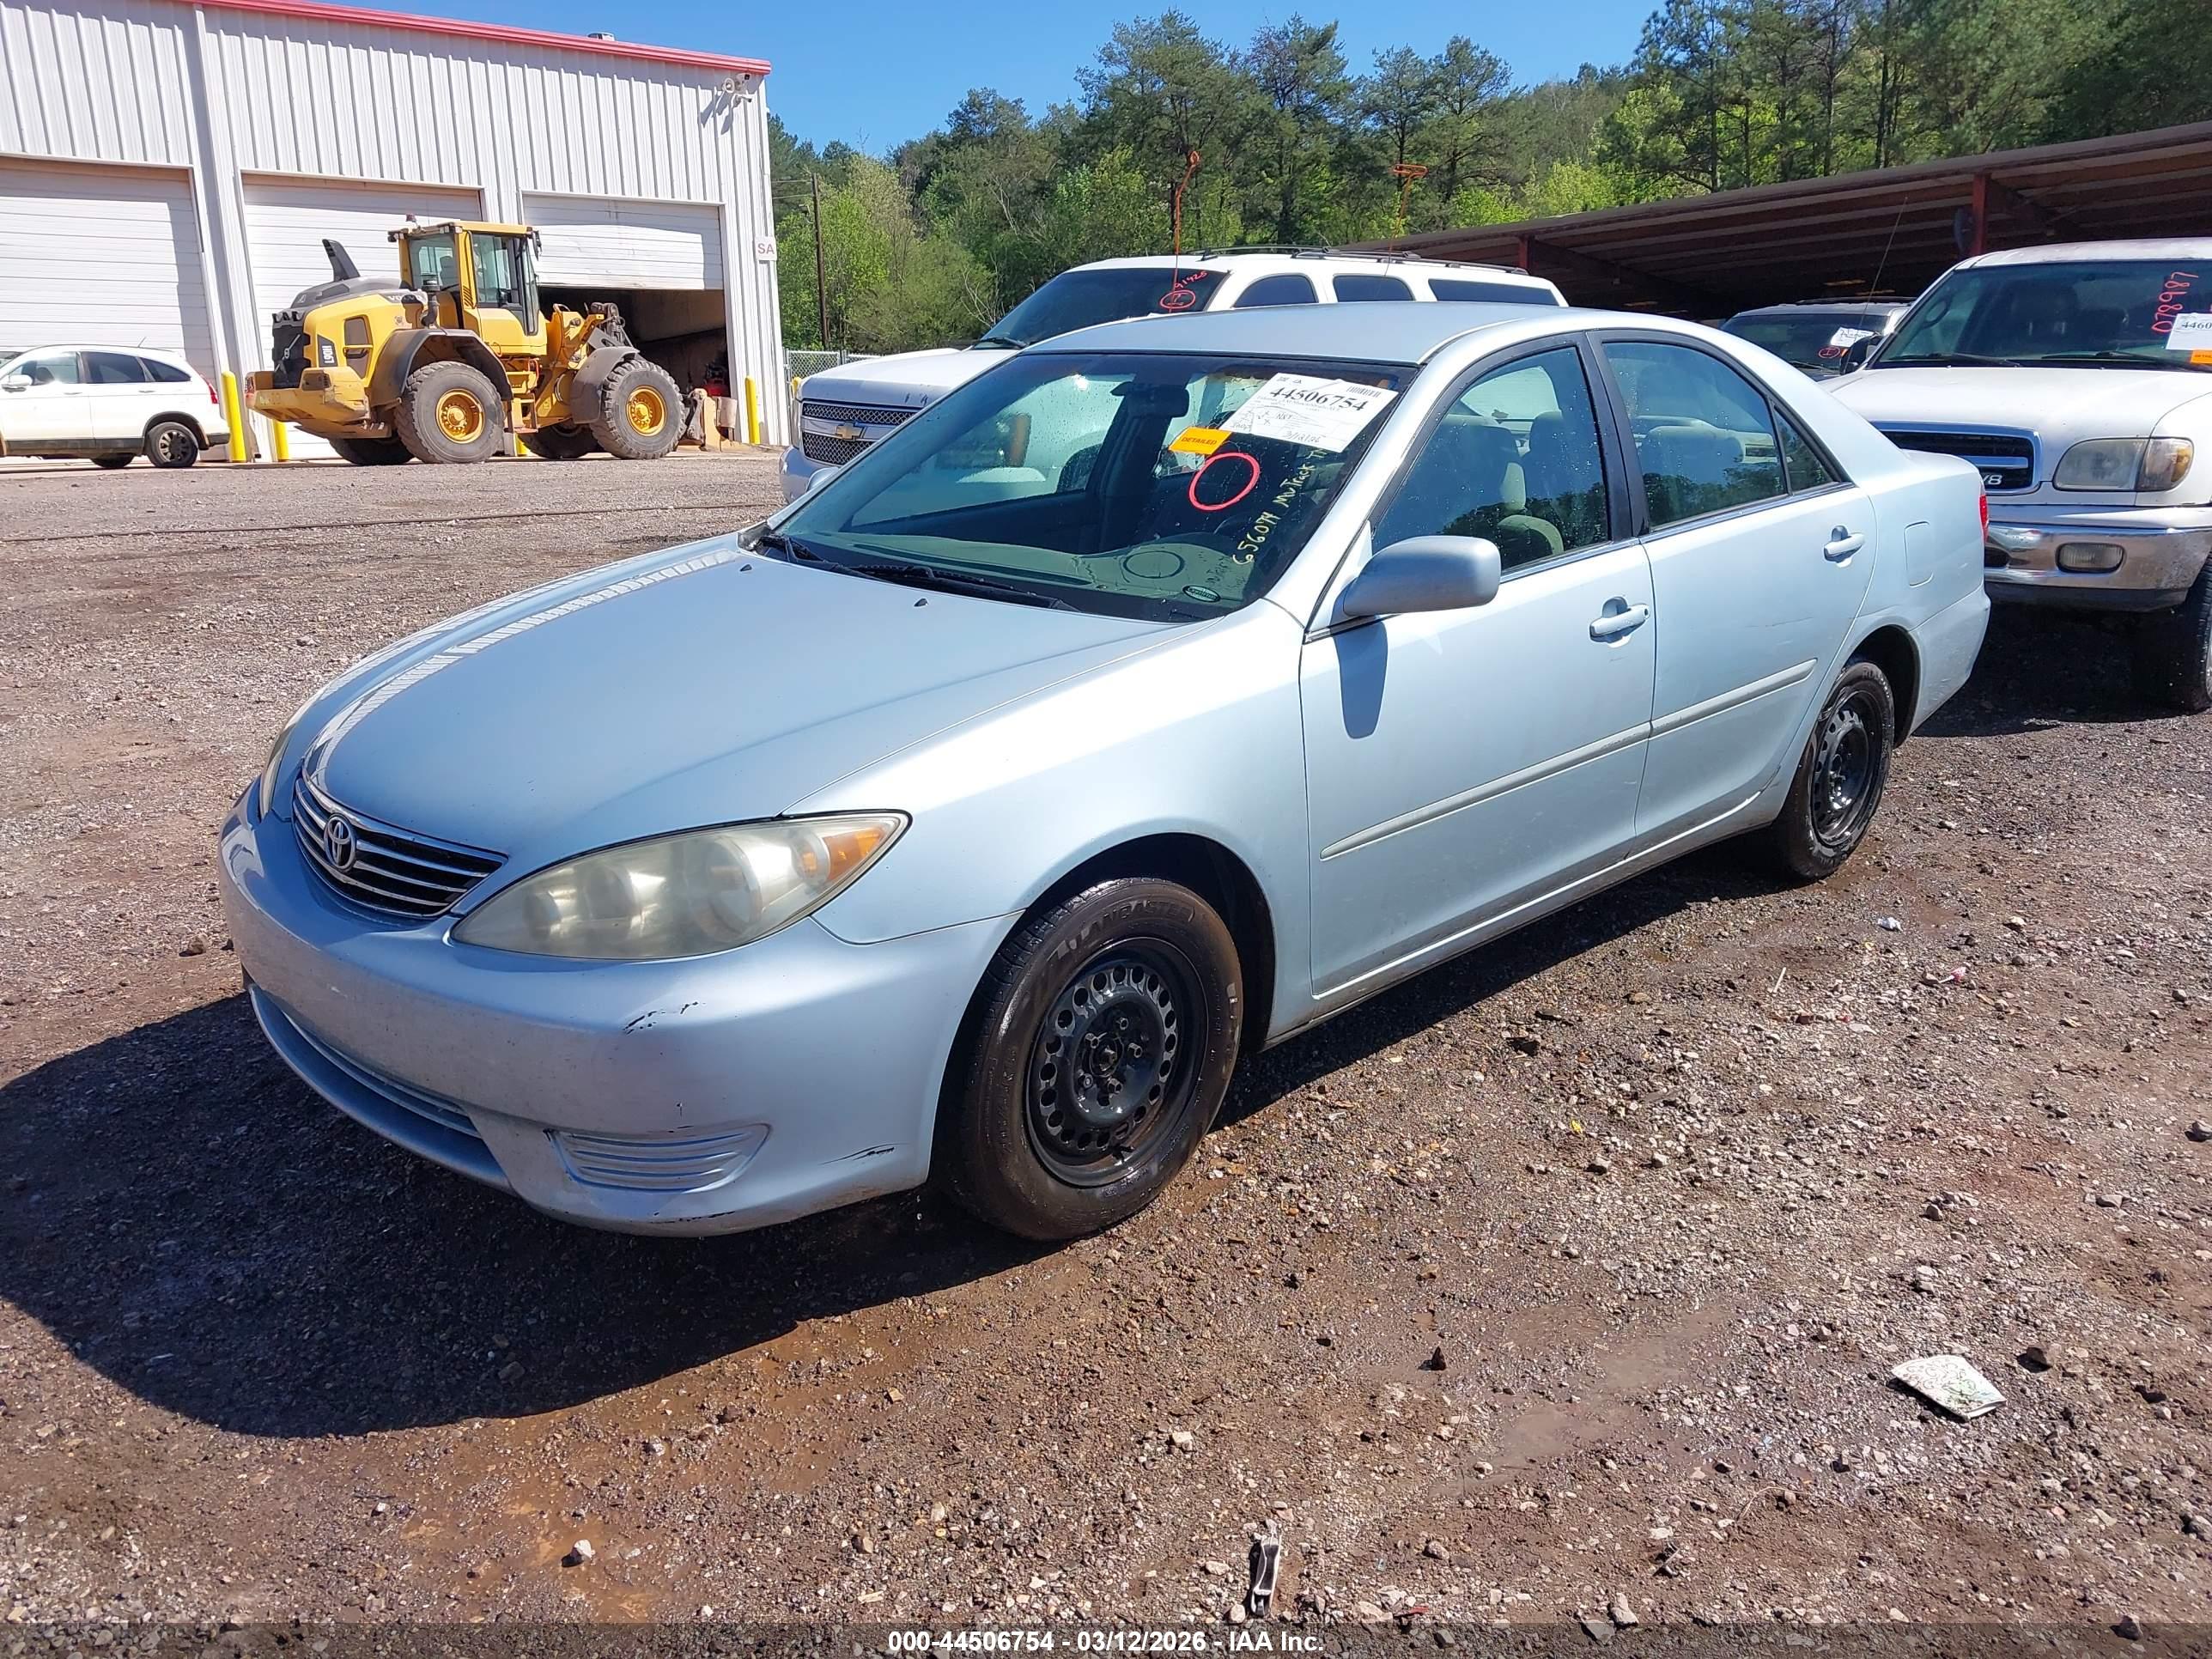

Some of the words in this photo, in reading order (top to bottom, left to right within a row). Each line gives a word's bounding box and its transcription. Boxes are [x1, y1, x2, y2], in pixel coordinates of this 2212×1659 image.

[757, 242, 775, 255] SA
[1269, 386, 1370, 411] 44506754
[1180, 436, 1218, 446] DETAILED
